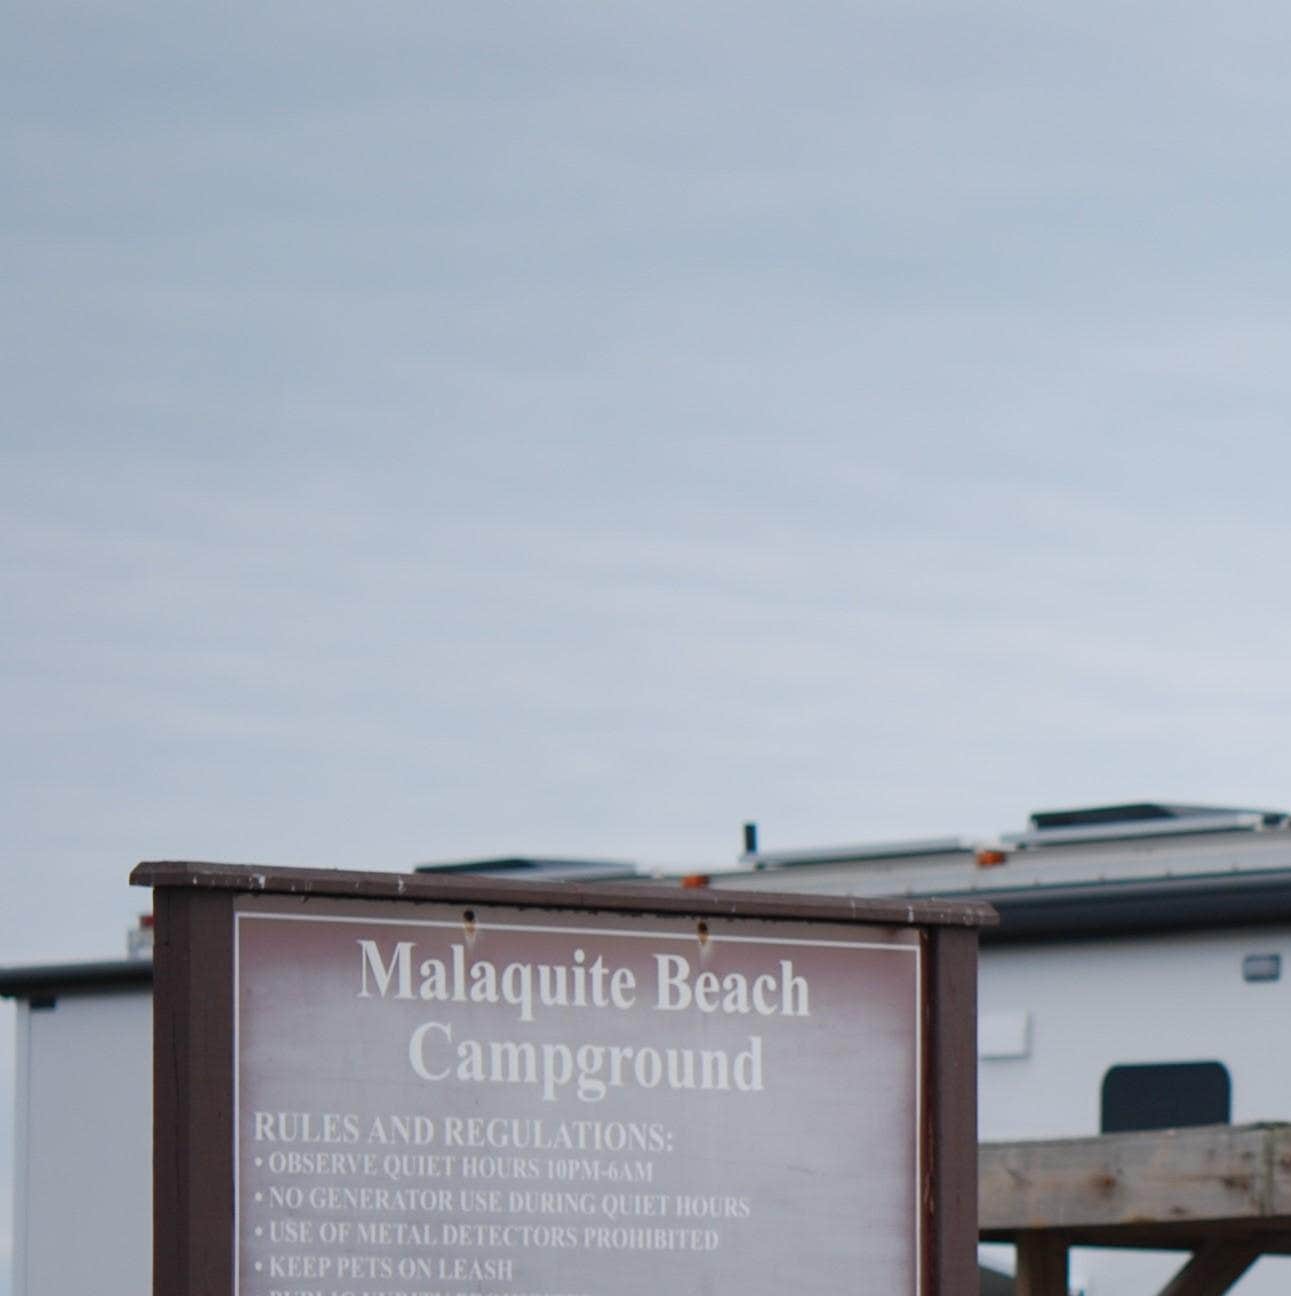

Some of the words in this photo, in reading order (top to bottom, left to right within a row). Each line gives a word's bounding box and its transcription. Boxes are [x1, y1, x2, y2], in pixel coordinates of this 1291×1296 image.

[357, 940, 636, 1021] Malaquite
[652, 953, 810, 1016] Beach
[409, 1022, 765, 1102] Campground
[254, 1112, 360, 1143] RULES
[368, 1115, 434, 1145] AND
[444, 1117, 674, 1151] REGULATIONS:
[269, 1151, 377, 1176] OBSERVE
[383, 1154, 460, 1180] QUIET
[462, 1156, 540, 1178] HOURS
[547, 1158, 653, 1182] 10PM-6AM
[269, 1186, 302, 1208] NO
[309, 1186, 453, 1211] GENERATOR
[460, 1190, 502, 1212] USE
[509, 1191, 596, 1215] DURING
[601, 1194, 670, 1219] QUIET
[675, 1197, 750, 1218] HOURS
[269, 1221, 313, 1243] USE
[320, 1221, 350, 1244] OF
[357, 1222, 437, 1246] METAL
[442, 1224, 578, 1247] DETECTORS
[584, 1228, 719, 1250] PROHIBITED
[269, 1256, 331, 1278] KEEP
[337, 1256, 392, 1279] PETS
[398, 1257, 432, 1279] ON
[439, 1258, 513, 1281] LEASH
